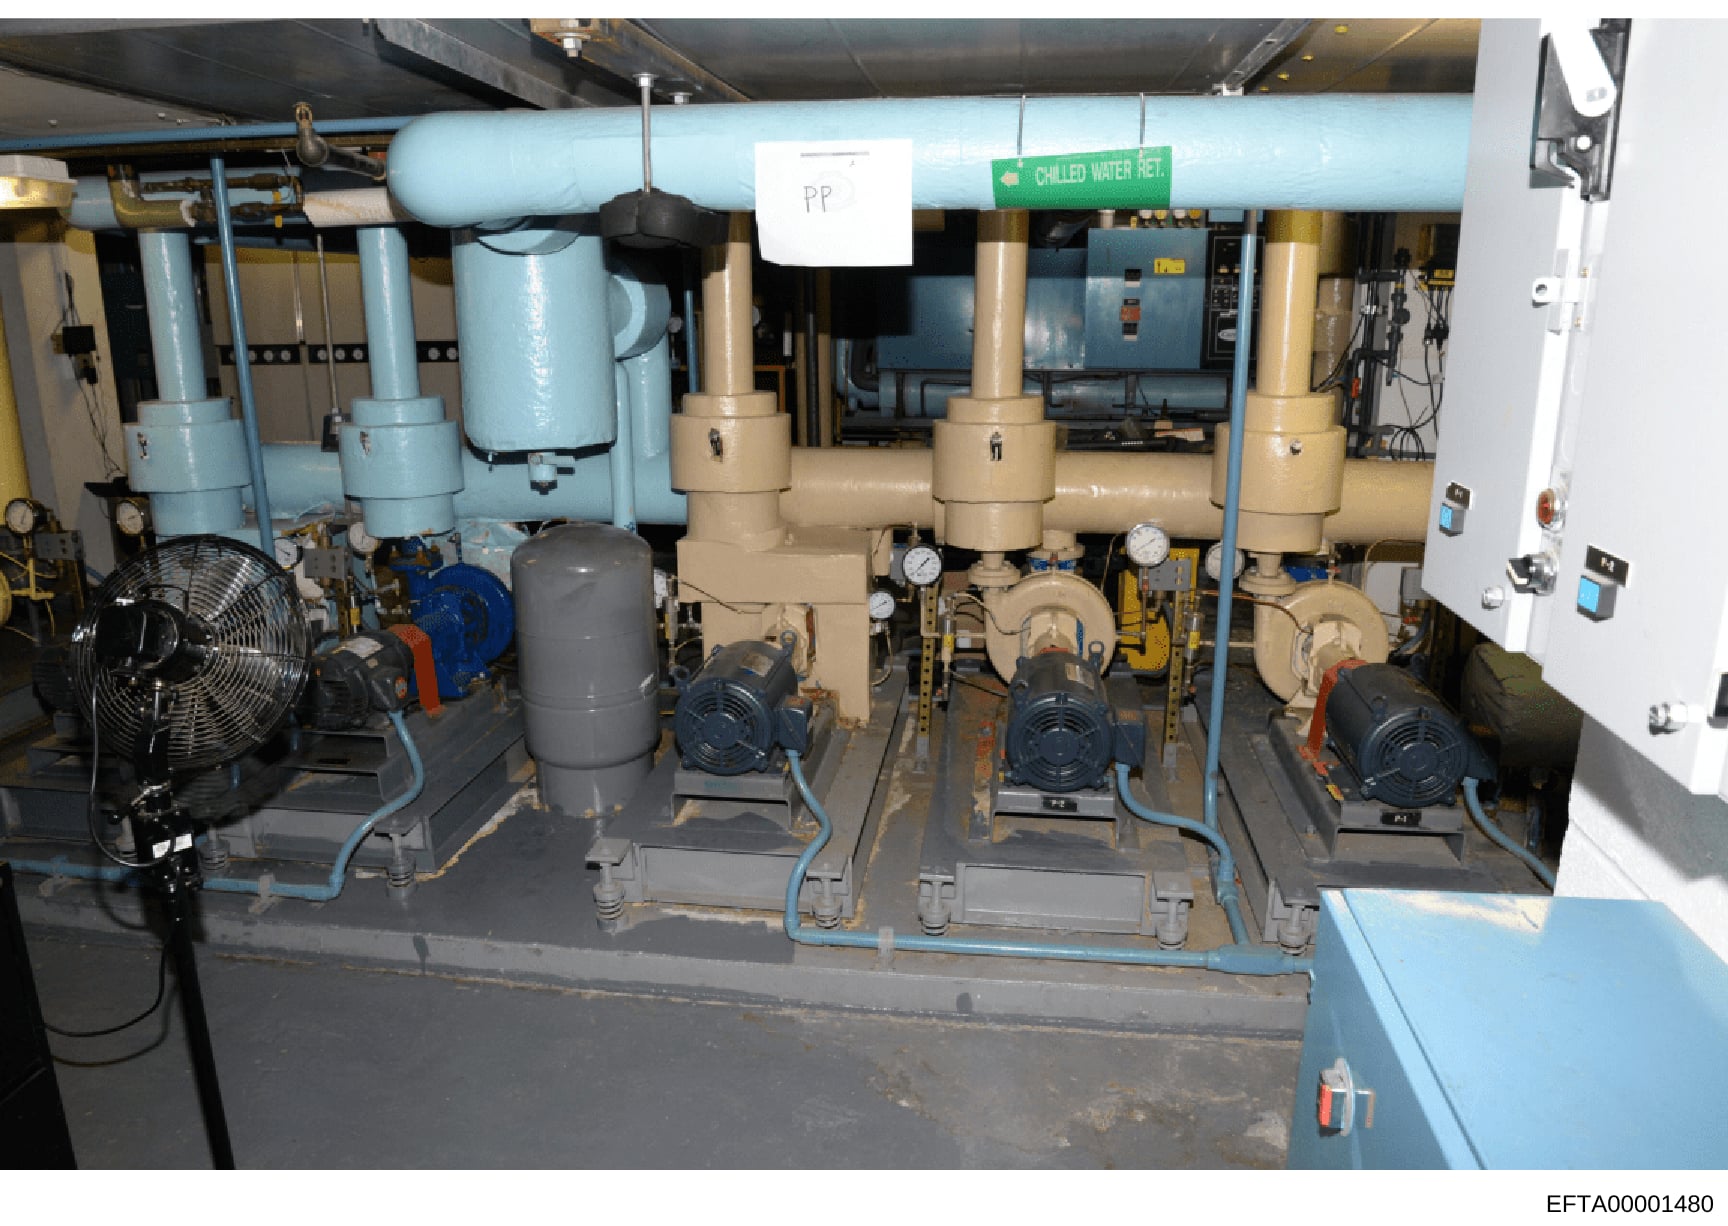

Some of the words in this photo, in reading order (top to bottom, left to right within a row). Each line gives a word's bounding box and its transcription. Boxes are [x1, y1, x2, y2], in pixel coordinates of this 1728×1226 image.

[1035, 164, 1086, 185] CHILLED
[1091, 159, 1131, 182] WATER
[1138, 157, 1165, 178] RET.
[803, 185, 832, 213] PP
